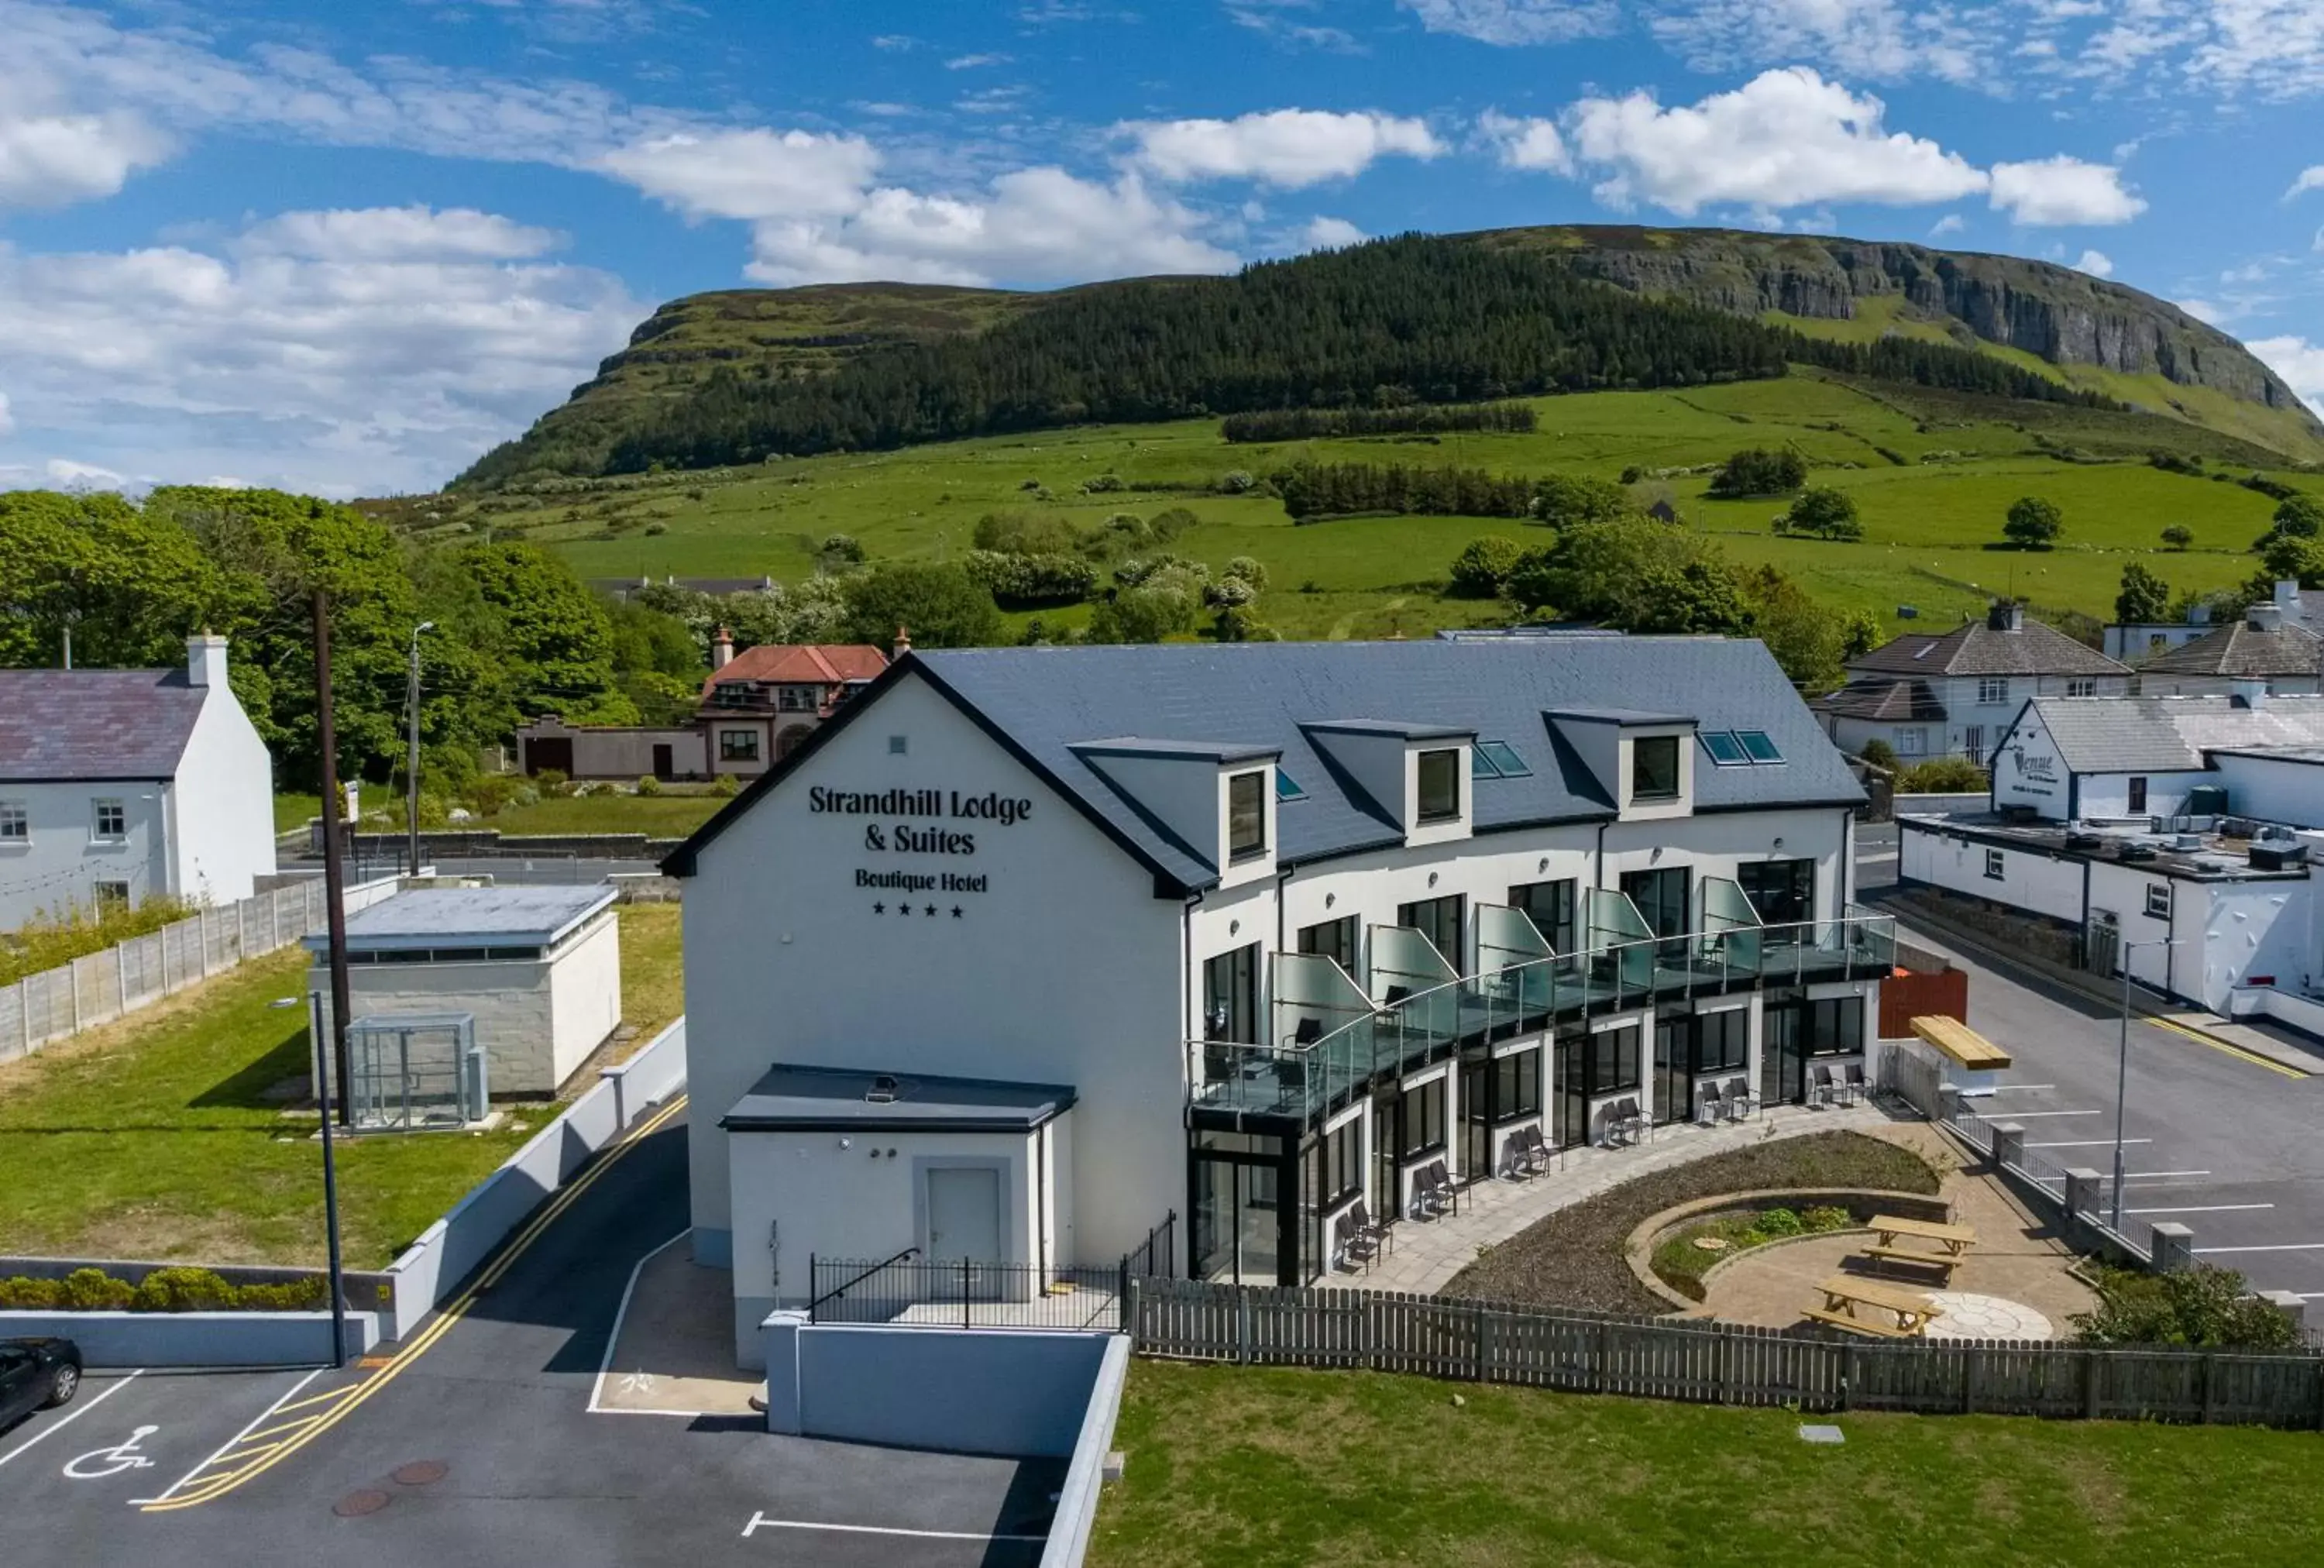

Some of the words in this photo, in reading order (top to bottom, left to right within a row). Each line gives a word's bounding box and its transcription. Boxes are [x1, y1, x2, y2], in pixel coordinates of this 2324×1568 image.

[2014, 752, 2053, 773] Venue
[810, 786, 942, 817] Strandhill
[951, 790, 1032, 827] Lodge
[865, 824, 887, 851] &
[894, 825, 976, 855] Suites
[855, 868, 937, 893] Boutique
[941, 872, 988, 893] Hotel
